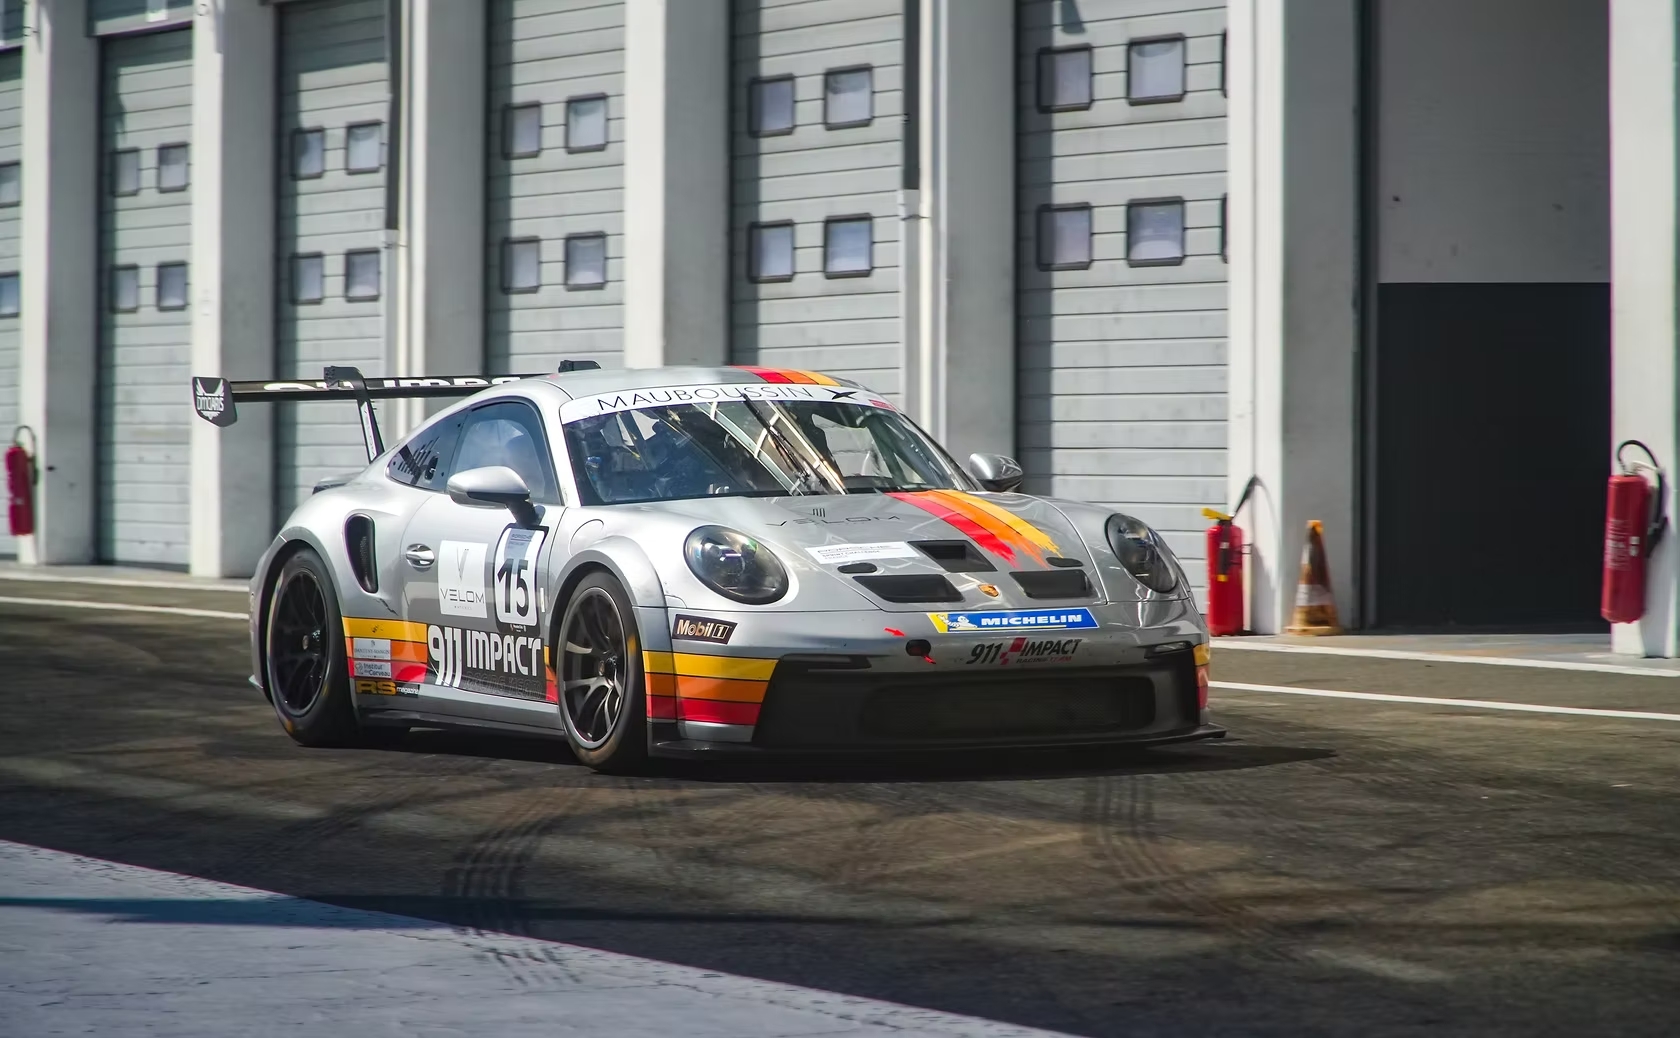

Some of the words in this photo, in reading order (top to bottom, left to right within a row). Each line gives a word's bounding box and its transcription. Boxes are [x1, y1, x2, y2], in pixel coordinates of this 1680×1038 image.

[597, 386, 813, 411] MAUBOUSSIN
[440, 588, 485, 604] VELOM
[497, 558, 529, 617] 15
[677, 620, 714, 637] Mobil
[981, 615, 1082, 625] MICHELIN
[428, 625, 462, 689] 911
[466, 630, 541, 676] IMPACT
[966, 643, 1003, 664] 911
[1019, 639, 1082, 656] IMPACT
[357, 681, 396, 695] RS
